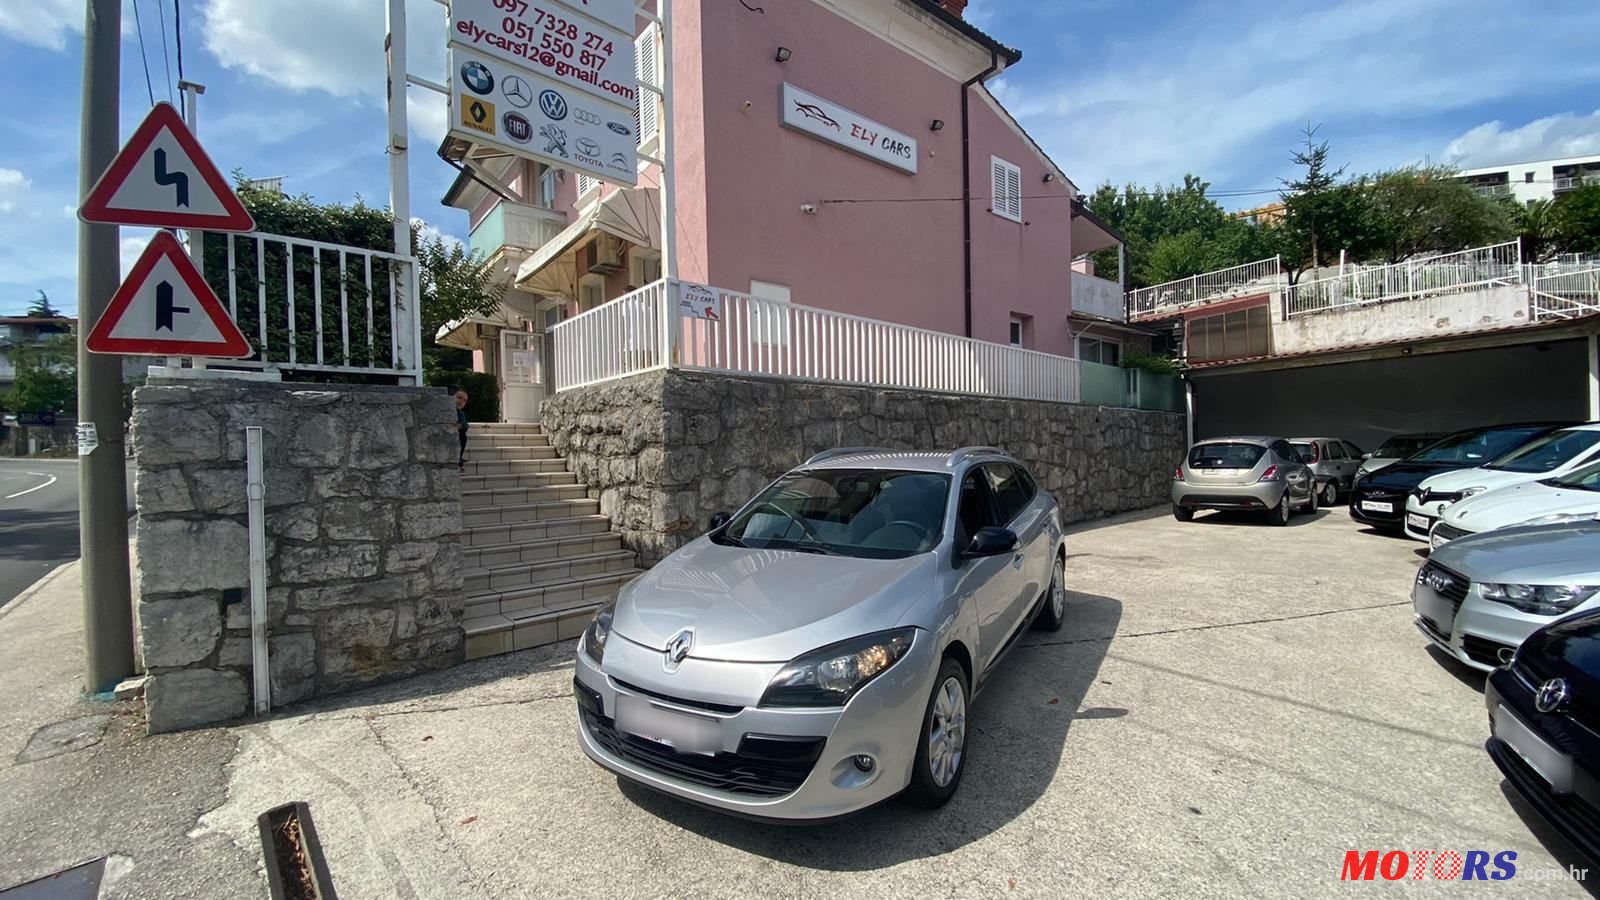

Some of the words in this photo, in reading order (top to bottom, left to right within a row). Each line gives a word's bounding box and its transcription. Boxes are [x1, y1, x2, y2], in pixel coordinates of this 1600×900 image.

[502, 17, 534, 42] 051
[540, 33, 574, 58] 550
[580, 50, 606, 71] 817
[534, 7, 578, 40] 7328
[583, 32, 613, 56] 274
[456, 20, 634, 100] elycars12@gmail.com
[509, 119, 526, 137] FIAT
[850, 123, 878, 147] ELY
[881, 137, 911, 159] CARS
[574, 153, 604, 168] TOYOTA
